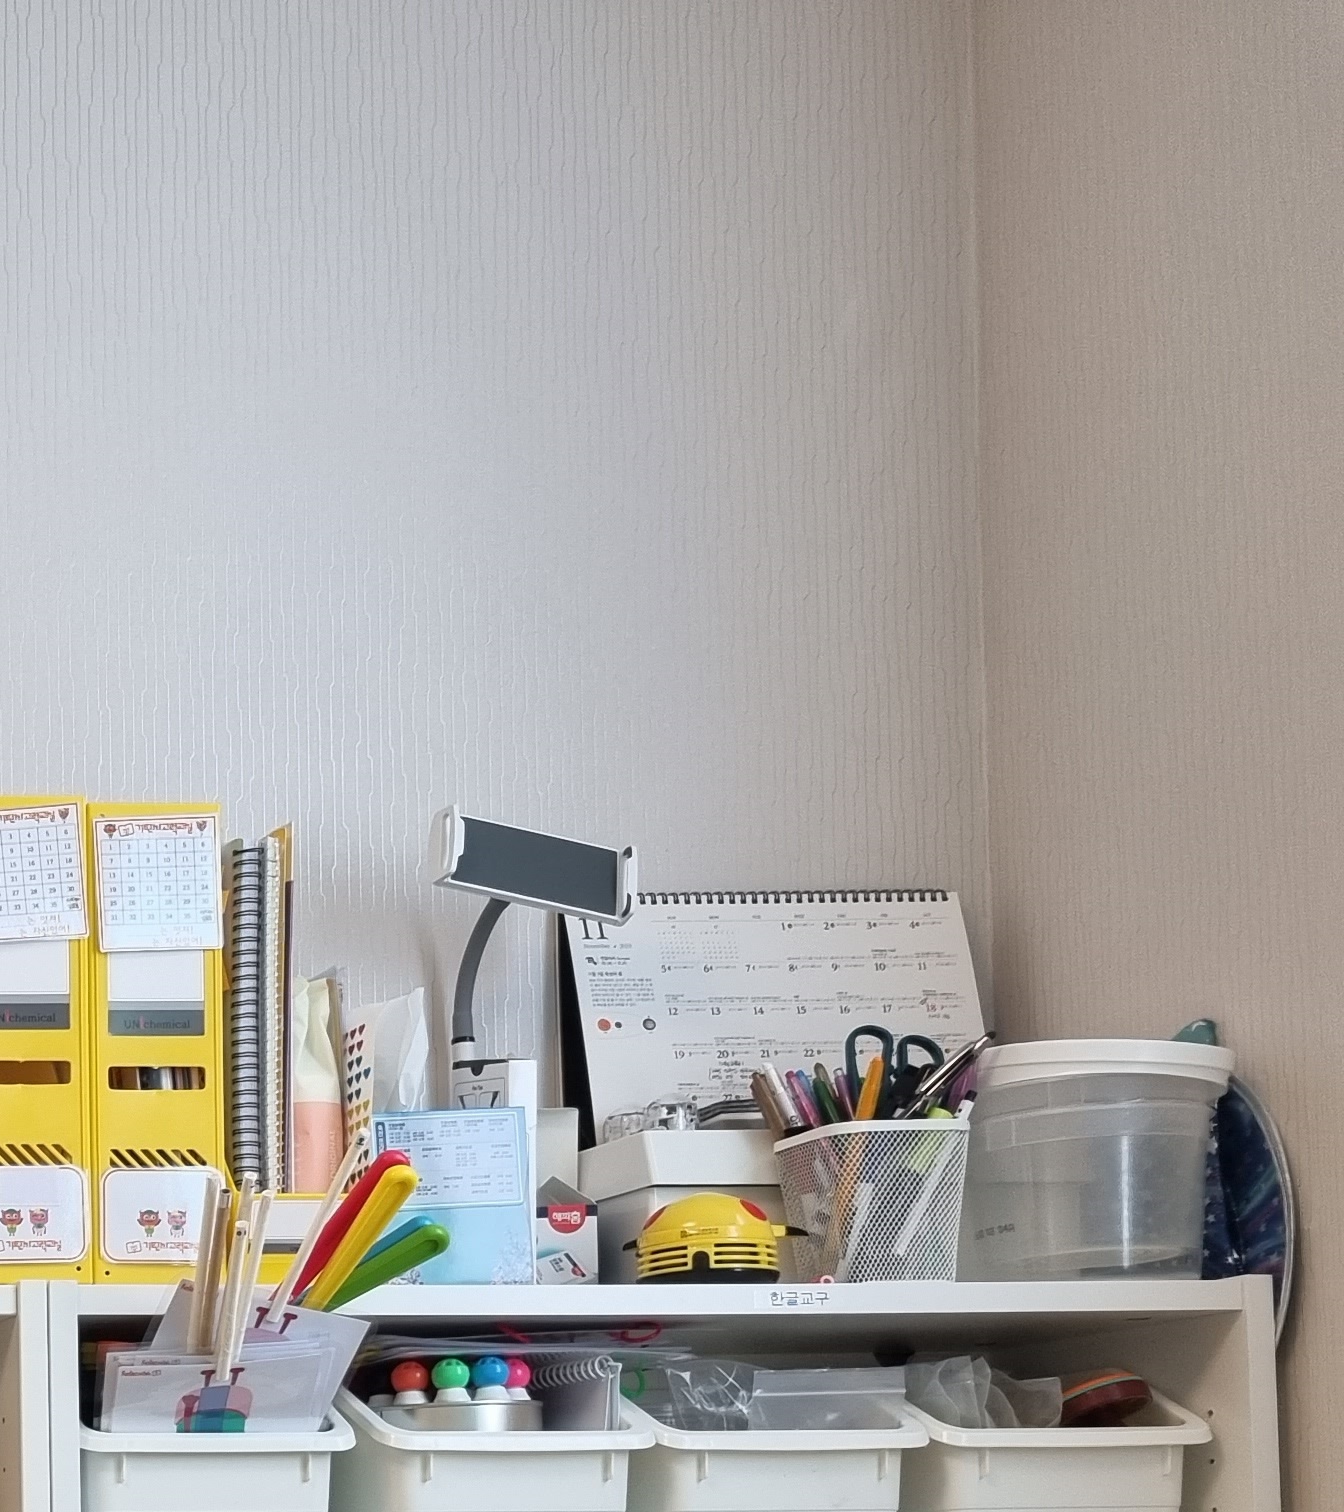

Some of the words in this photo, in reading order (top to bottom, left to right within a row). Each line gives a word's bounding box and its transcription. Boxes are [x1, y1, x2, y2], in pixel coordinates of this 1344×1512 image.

[874, 962, 886, 972] 10
[917, 962, 927, 971] 11
[668, 1006, 679, 1016] 12
[753, 1006, 764, 1016] 14
[796, 1005, 807, 1015] 15
[882, 1004, 893, 1013] 17
[769, 1291, 830, 1307] 한글교구
